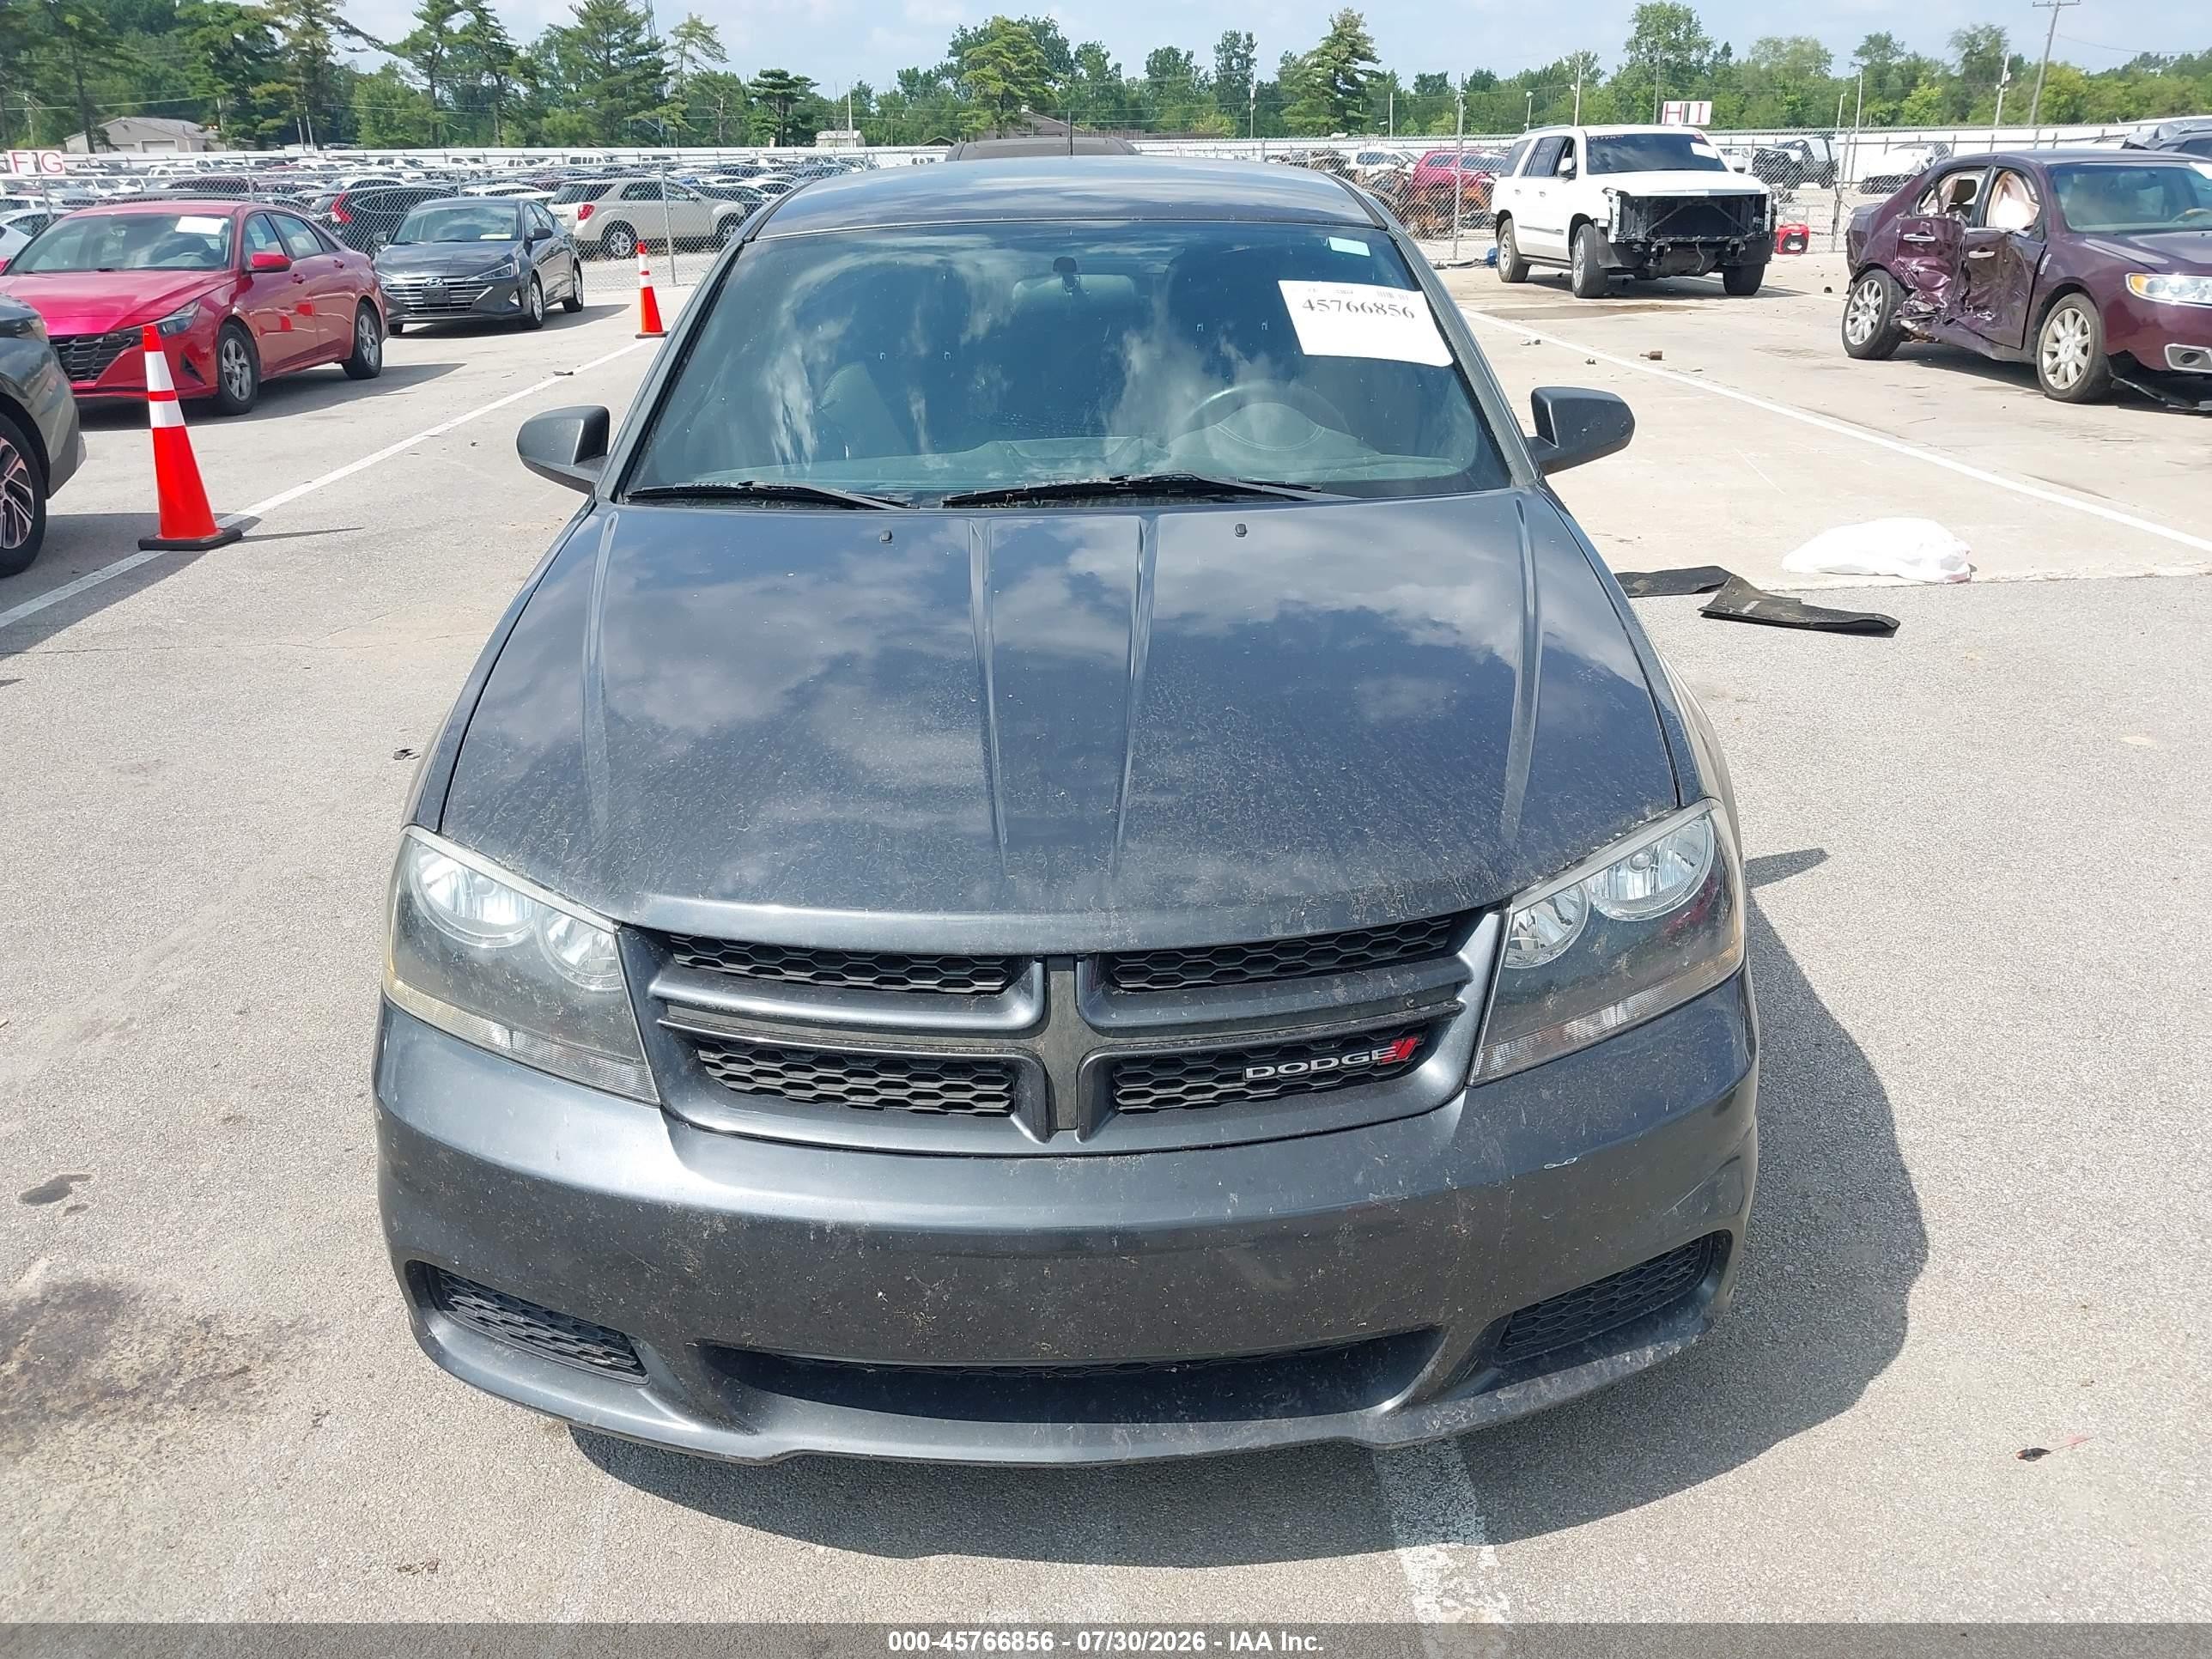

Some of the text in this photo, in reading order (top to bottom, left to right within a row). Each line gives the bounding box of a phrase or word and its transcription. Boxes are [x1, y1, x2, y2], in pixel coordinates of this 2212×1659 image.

[1664, 102, 1683, 125] H
[11, 152, 64, 173] F G
[1302, 298, 1415, 319] 45766856
[1245, 1046, 1398, 1079] DODGE
